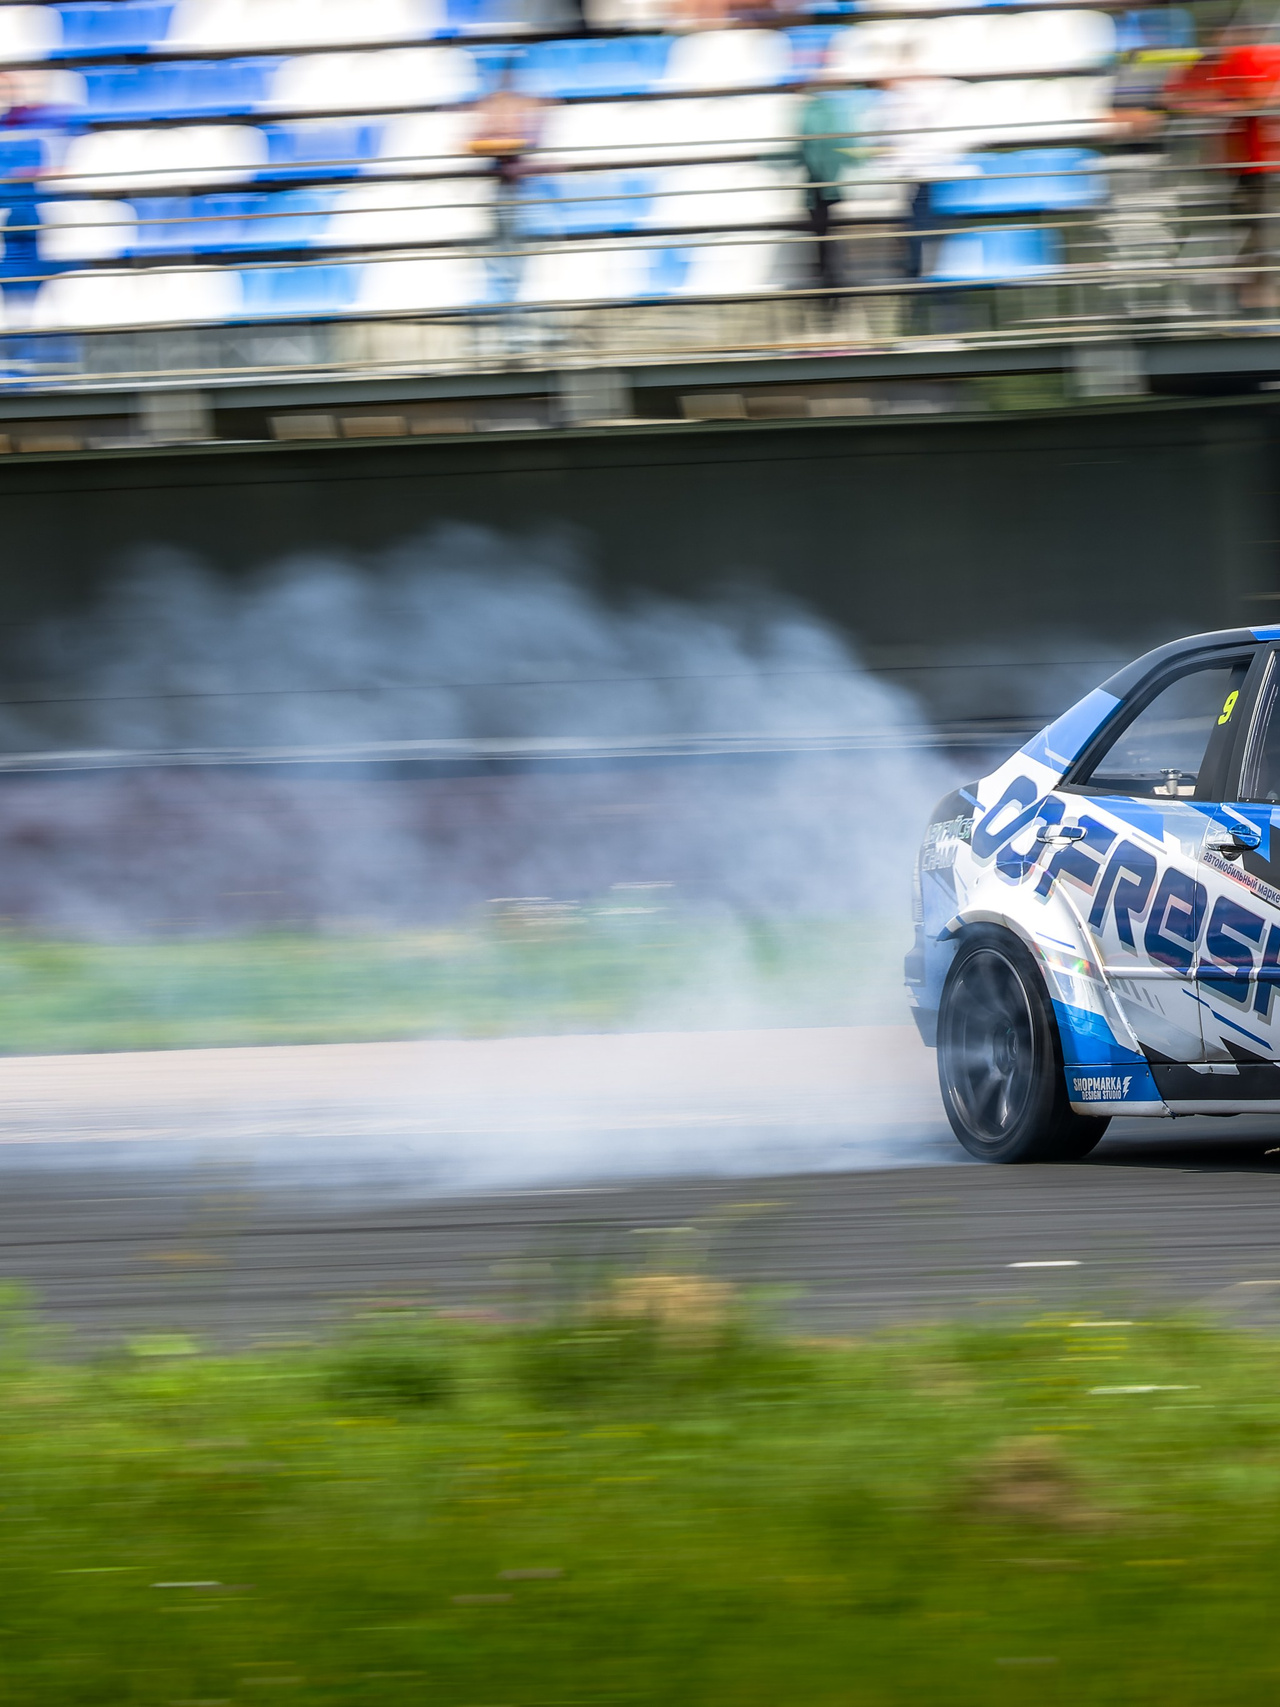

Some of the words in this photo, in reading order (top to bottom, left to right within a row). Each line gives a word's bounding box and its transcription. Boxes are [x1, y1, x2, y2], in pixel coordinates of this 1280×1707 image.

[1203, 851, 1258, 891] автомобильный
[1073, 1077, 1122, 1091] SHOPMARKA
[1082, 1091, 1101, 1100] DESIGN
[1103, 1091, 1121, 1100] STUDIO
